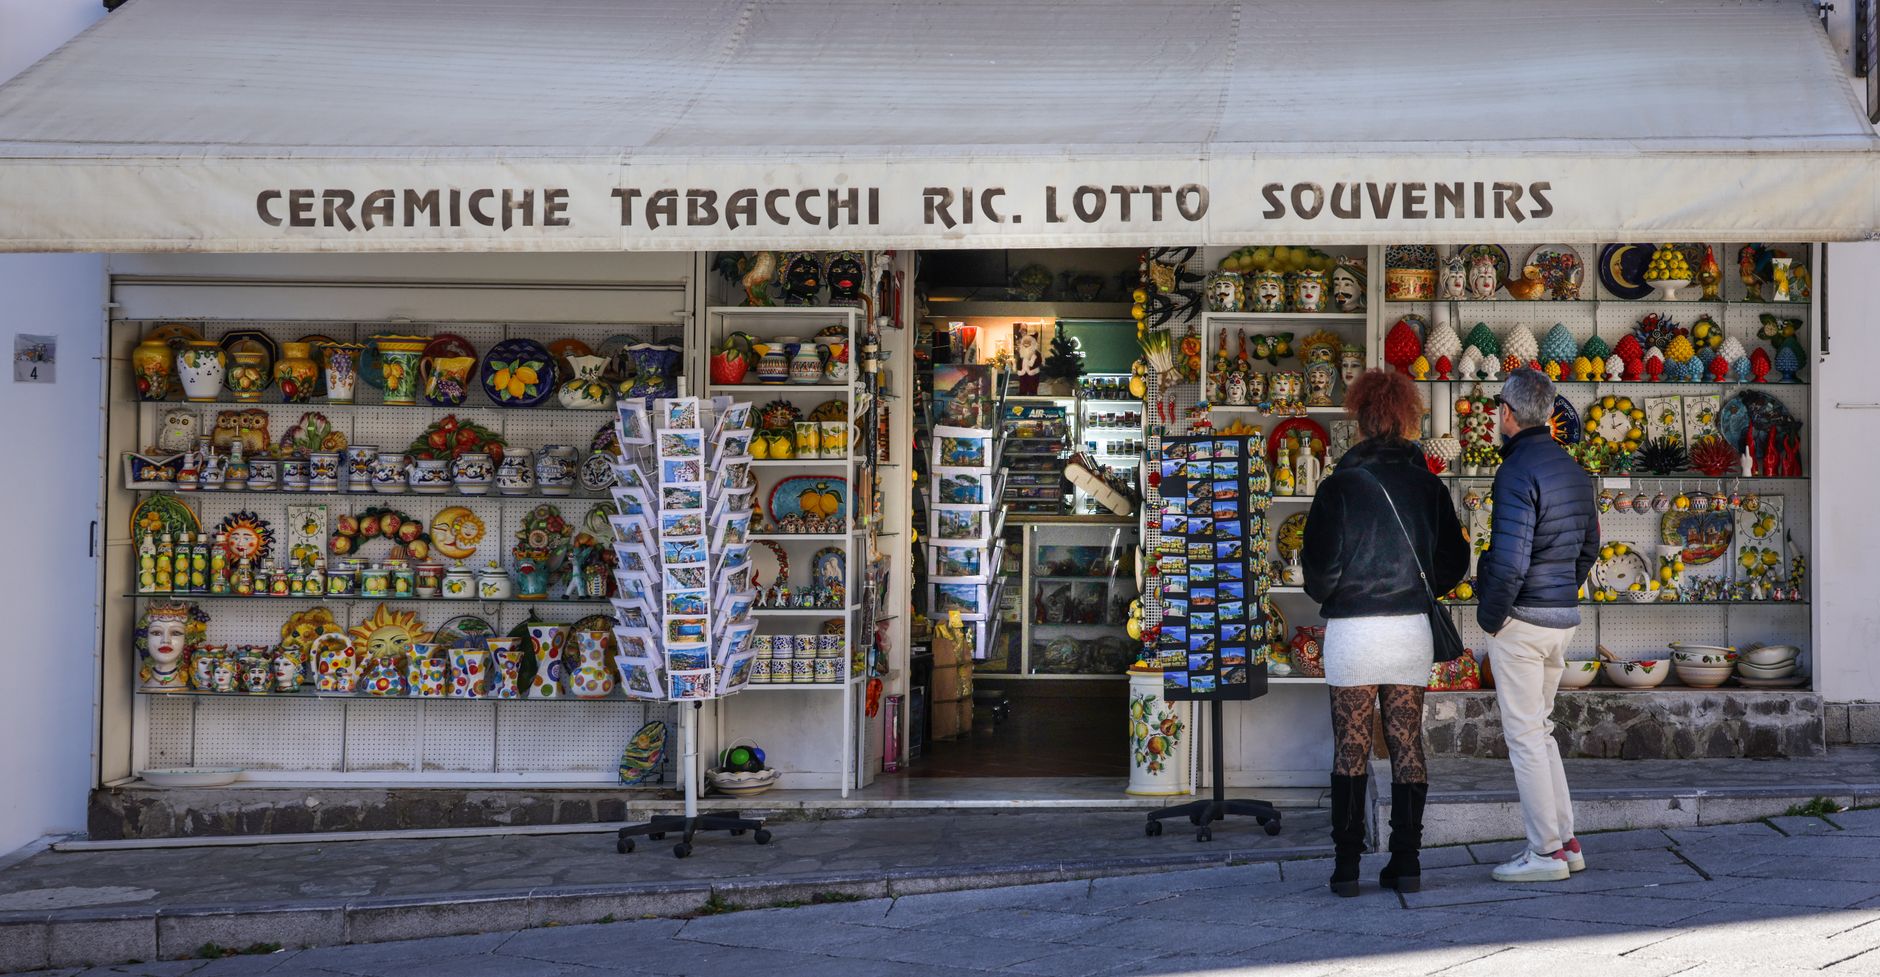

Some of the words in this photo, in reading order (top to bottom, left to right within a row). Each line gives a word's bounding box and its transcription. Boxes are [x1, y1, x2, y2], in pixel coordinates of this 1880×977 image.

[256, 188, 571, 232] CERAMICHE
[610, 187, 880, 231] TABACCHI
[922, 186, 1022, 230] RIC.
[1046, 183, 1210, 223] LOTTO
[1261, 181, 1554, 224] SOUVENIRS
[30, 366, 38, 380] 4
[1028, 409, 1045, 418] AIR
